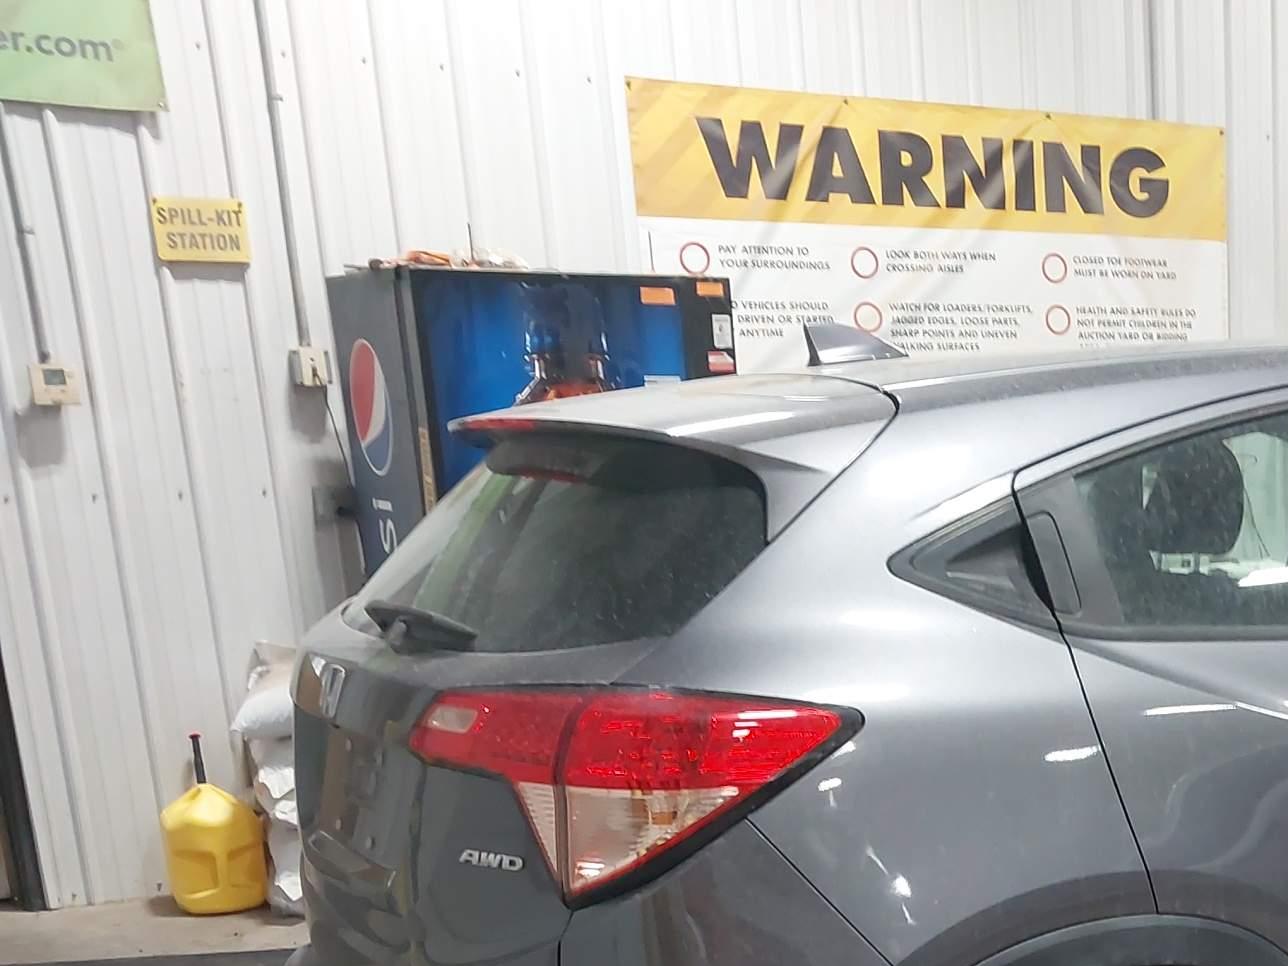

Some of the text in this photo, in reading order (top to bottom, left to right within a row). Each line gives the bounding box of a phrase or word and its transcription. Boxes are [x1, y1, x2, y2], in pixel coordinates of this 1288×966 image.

[697, 116, 1169, 218] WARNING
[157, 207, 242, 227] SPILL-KIT
[166, 232, 240, 252] STATION
[718, 245, 809, 256] PAY ATTENTION TO
[886, 250, 996, 261] LOOK BOTH WAYS WHEN
[720, 259, 831, 270] YOUR SURROUNDINGS
[1073, 256, 1167, 267] CLOSED TOE FOOTWEAR
[886, 263, 964, 273] CROSSING AISLES
[1074, 269, 1096, 277] MUST
[1112, 270, 1139, 279] WORN
[1141, 271, 1154, 279] ON
[1157, 271, 1176, 280] YARD
[743, 302, 786, 310] VEHICLES
[789, 302, 829, 310] SHOULD
[889, 302, 922, 312] WATCH
[924, 303, 940, 312] FOR
[1076, 306, 1107, 315] HEALTH
[1110, 307, 1128, 315] AND
[1131, 308, 1158, 316] SAFETY
[1185, 309, 1196, 317] DO
[738, 315, 775, 324] DRIVEN
[778, 315, 792, 323] OR
[891, 316, 924, 325] JAGGED
[961, 317, 989, 325] LOOSE
[1077, 319, 1192, 329] NOT PERMIT CHILDREN IN THE
[739, 329, 784, 337] ANYTIME
[891, 329, 1018, 339] SHARP POINTS AND UNEVEN
[1078, 331, 1115, 340] AUCTION
[1119, 332, 1139, 340] YARD
[1142, 332, 1153, 340] OR
[937, 342, 980, 351] SURFACES
[459, 848, 523, 871] AWD
